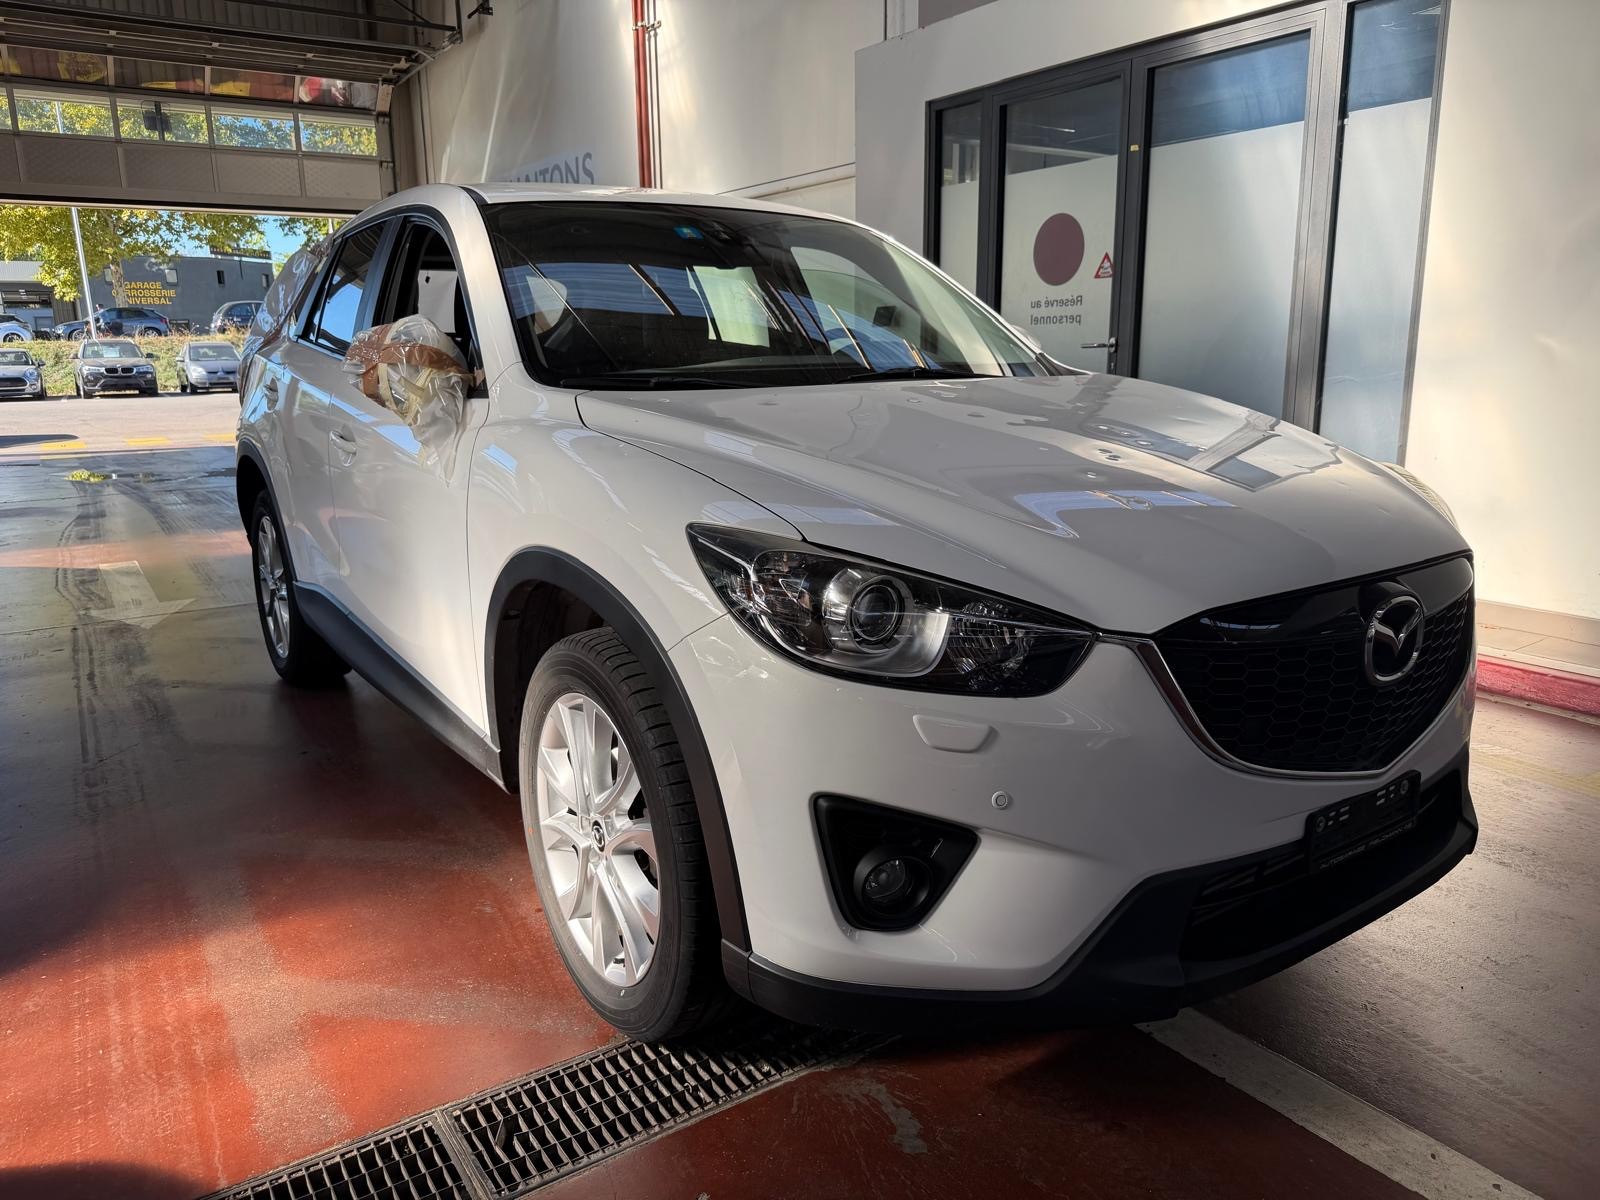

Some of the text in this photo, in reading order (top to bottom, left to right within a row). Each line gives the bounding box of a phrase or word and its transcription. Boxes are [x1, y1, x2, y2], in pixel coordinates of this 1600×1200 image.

[124, 281, 162, 289] GARAGE
[112, 289, 177, 297] CRROSSERIE
[125, 297, 172, 305] NIVERSAL
